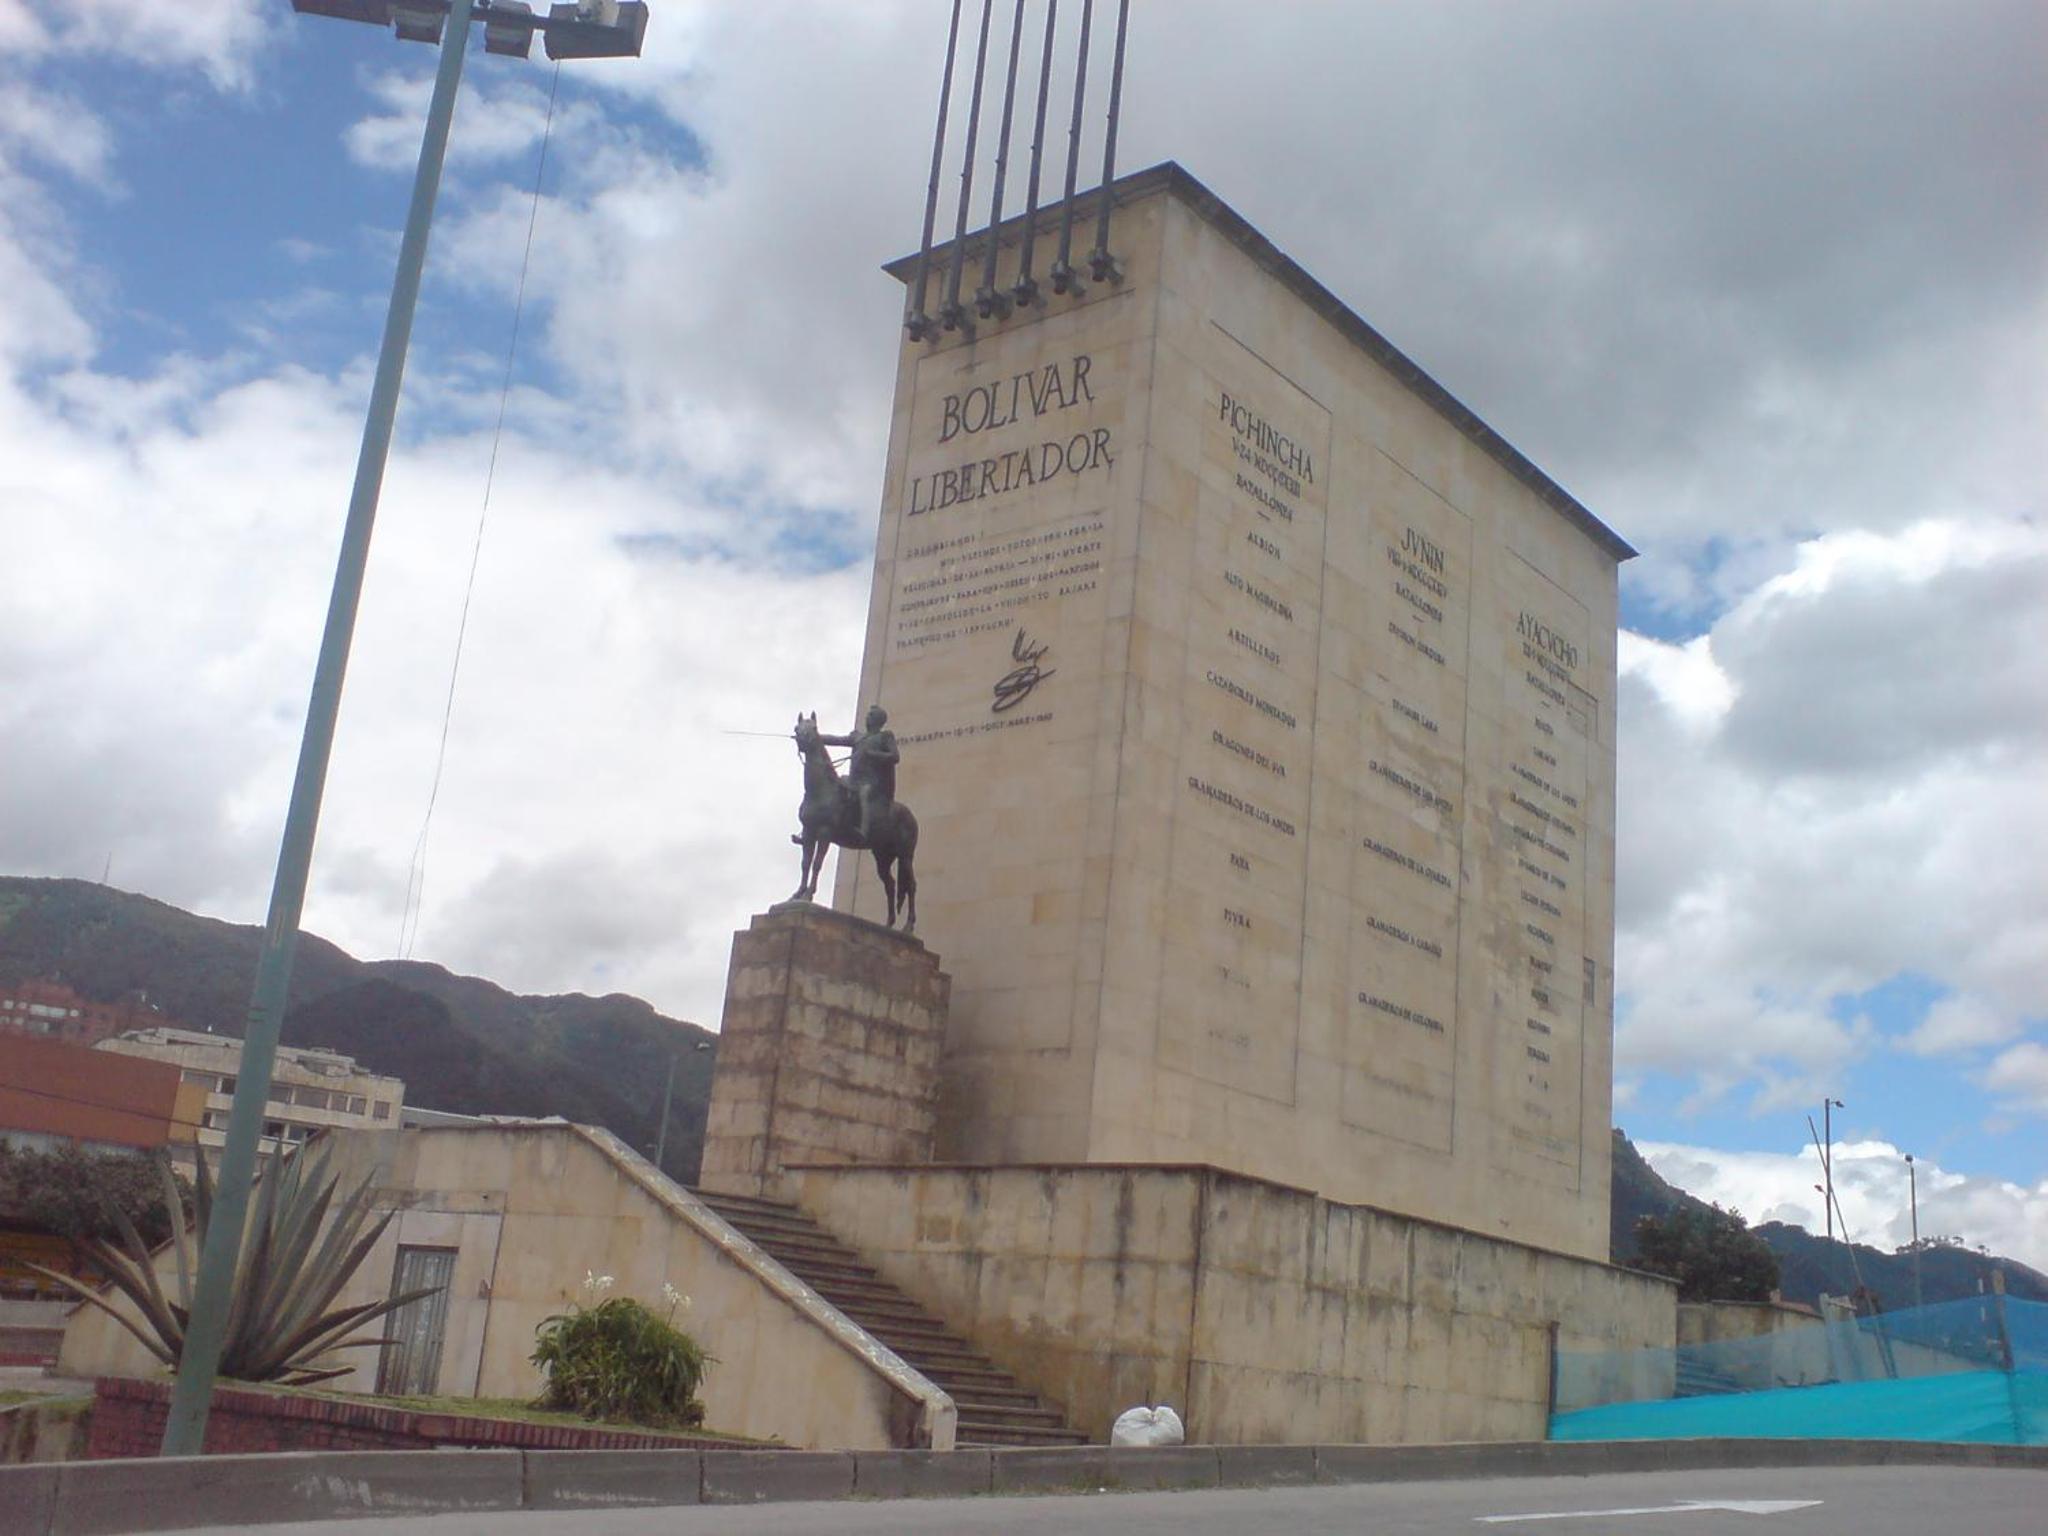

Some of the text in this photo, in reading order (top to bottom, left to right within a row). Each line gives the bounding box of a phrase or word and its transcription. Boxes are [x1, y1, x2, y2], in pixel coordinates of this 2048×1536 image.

[938, 356, 1095, 443] BOLIVAR
[1220, 392, 1313, 484] PICHINCHA
[907, 428, 1115, 516] LIBERTADOR
[1401, 528, 1445, 575] JVNIN
[1516, 611, 1578, 669] AYACVCHO
